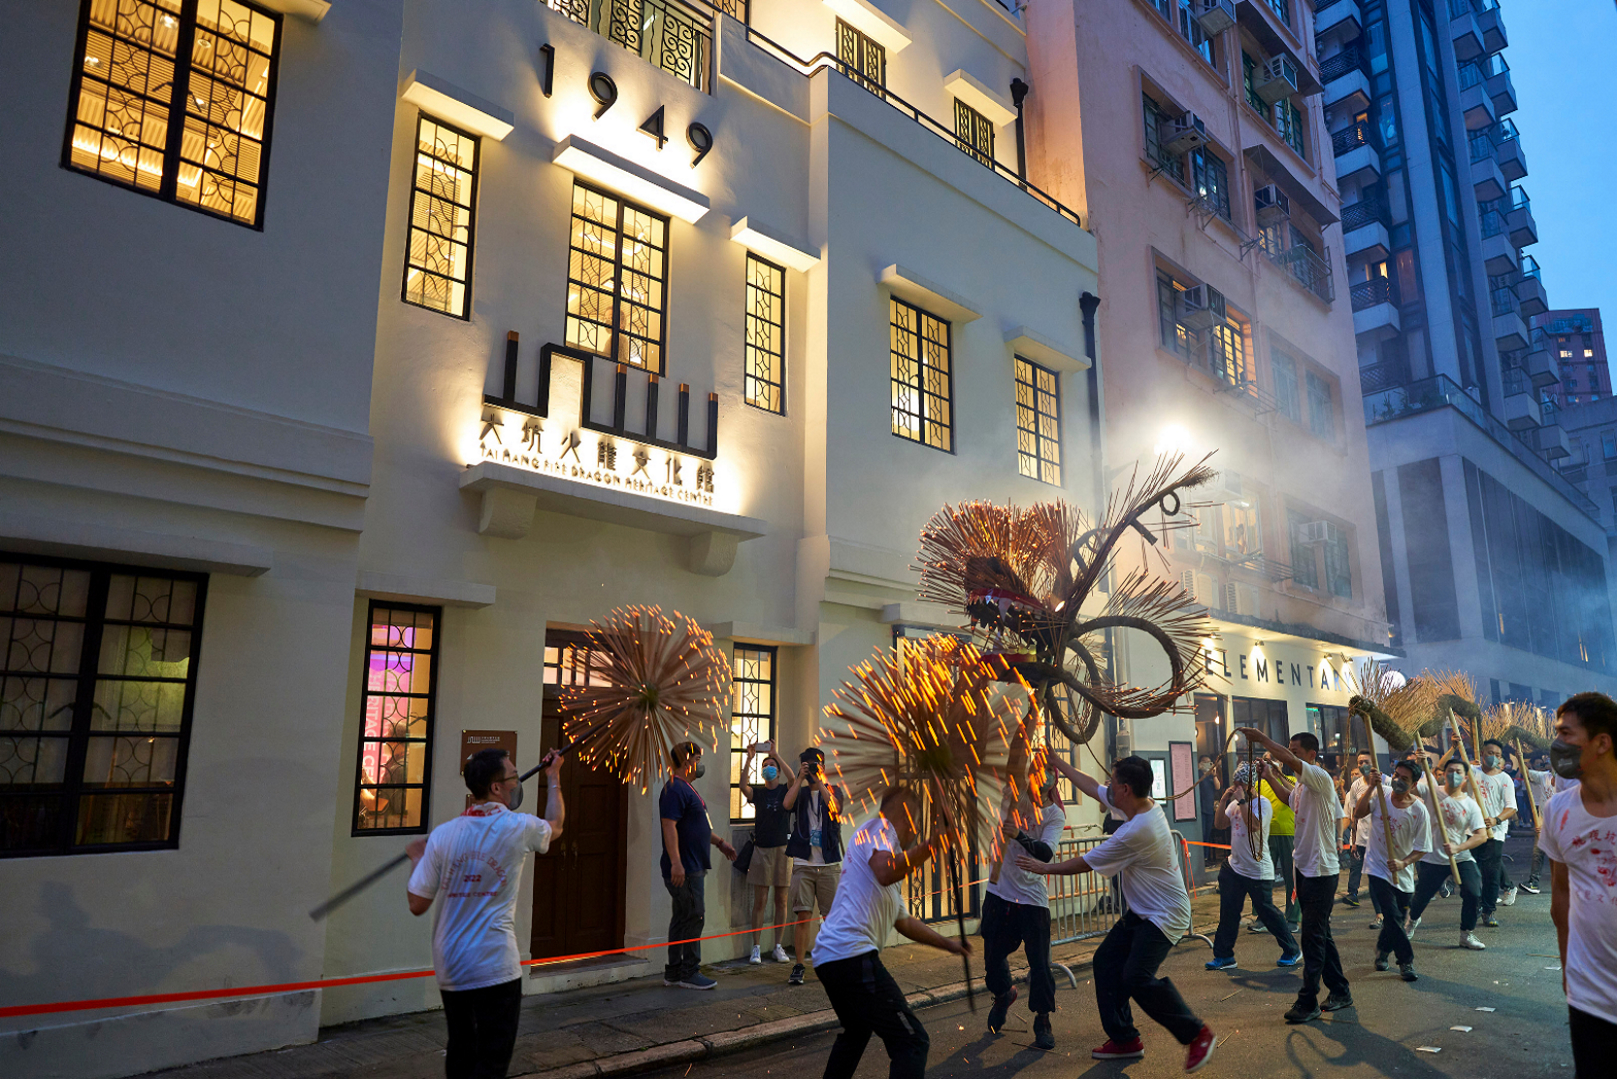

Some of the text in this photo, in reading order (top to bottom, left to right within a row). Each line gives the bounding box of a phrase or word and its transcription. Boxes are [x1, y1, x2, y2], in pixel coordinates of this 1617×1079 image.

[539, 43, 713, 169] 1949
[479, 413, 715, 494] 大坑火龍文化館
[480, 442, 714, 507] TAI HANG FIRE DRAGON HERITAGE CENTRE
